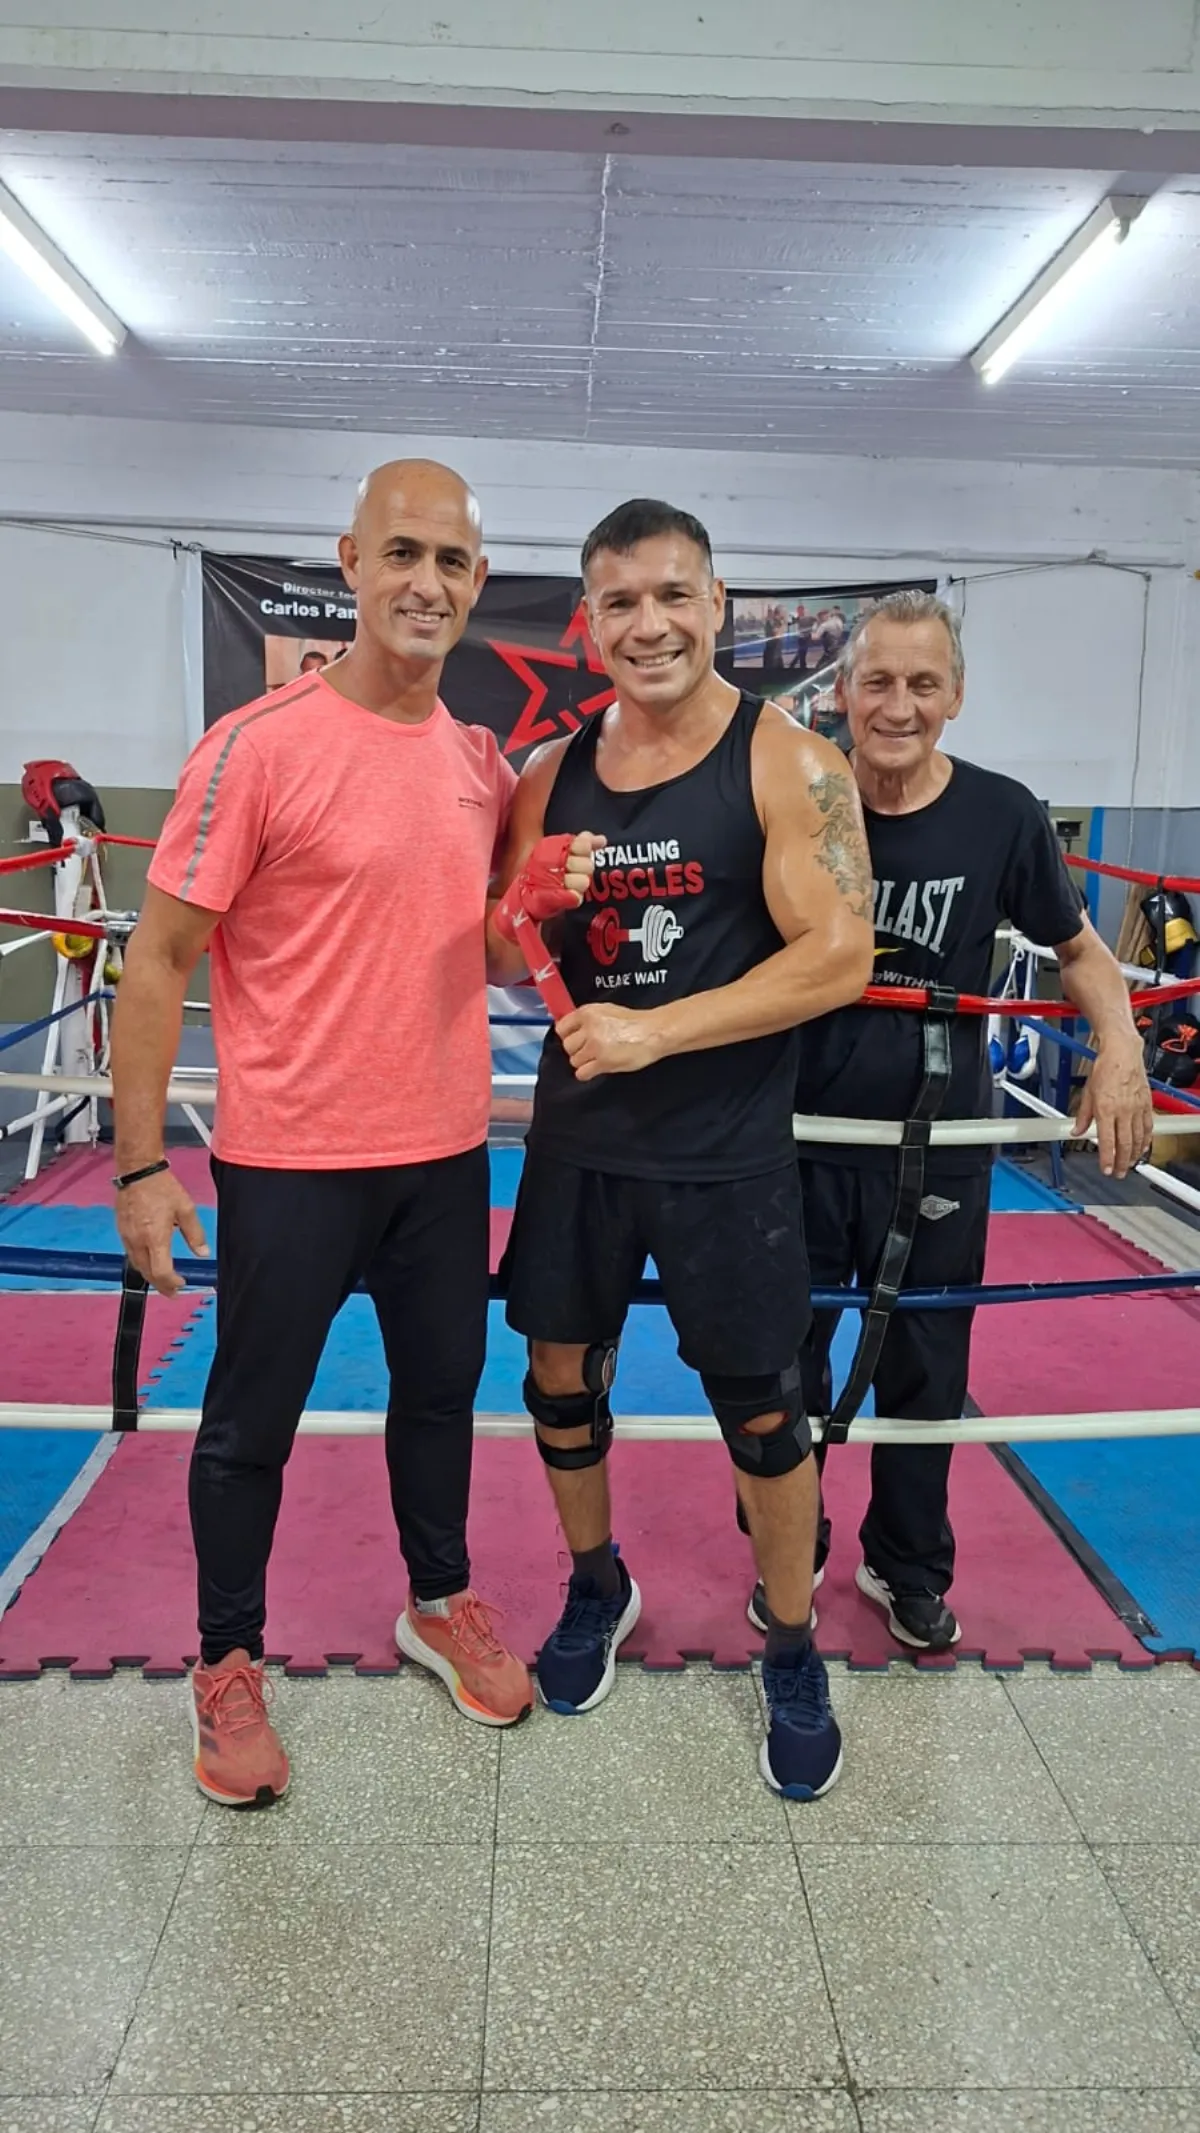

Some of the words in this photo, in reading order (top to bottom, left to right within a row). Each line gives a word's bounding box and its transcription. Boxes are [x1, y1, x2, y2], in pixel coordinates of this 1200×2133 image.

[283, 582, 336, 597] Director
[260, 599, 320, 617] Carlos
[590, 839, 680, 867] STALLING
[585, 861, 704, 902] USCLES
[635, 969, 668, 985] WAIT
